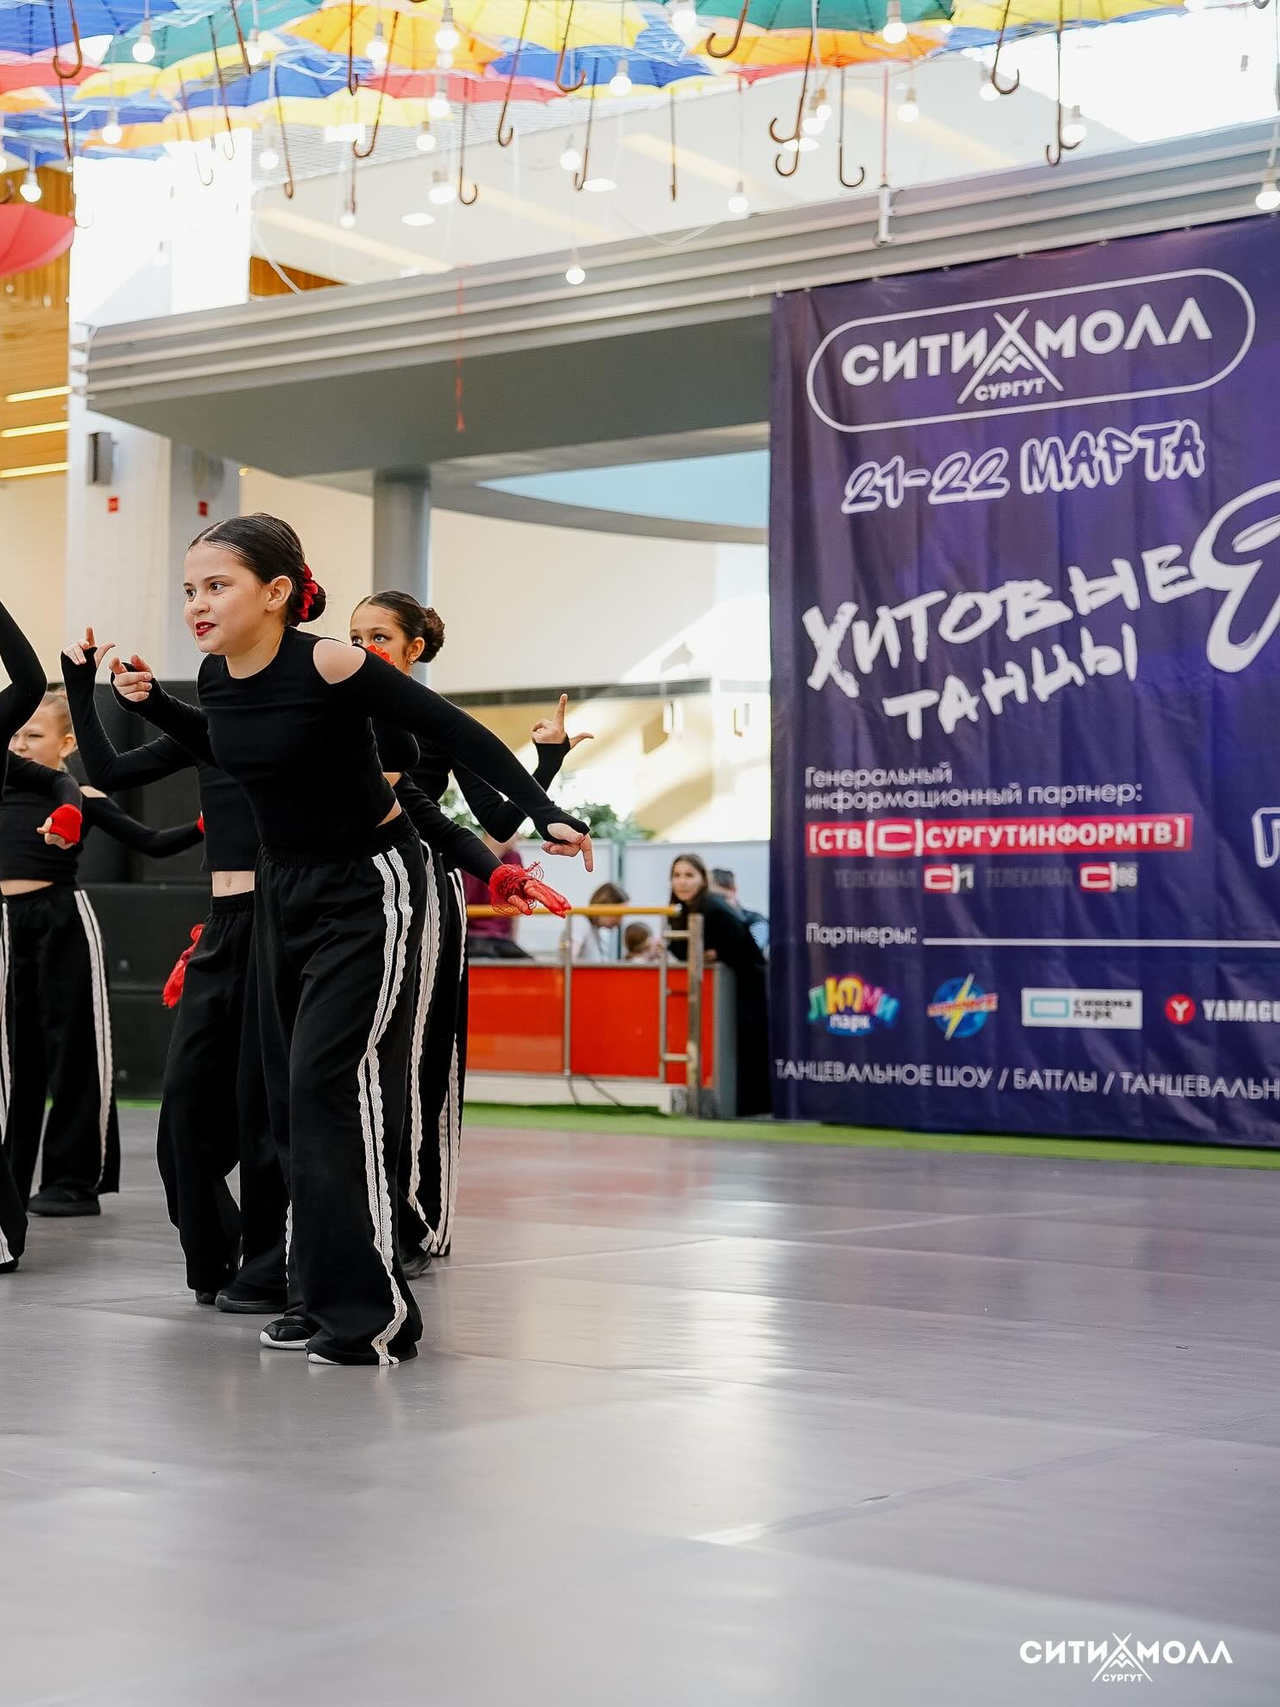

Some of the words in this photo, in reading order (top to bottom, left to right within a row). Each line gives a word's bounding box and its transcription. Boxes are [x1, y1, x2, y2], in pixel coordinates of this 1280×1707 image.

[841, 326, 988, 387] СИТИ
[1034, 296, 1213, 360] МОЛЛ
[973, 376, 1046, 402] СУРГУТ
[841, 446, 1010, 515] 21-22
[1019, 418, 1207, 495] МАРТА
[801, 544, 1204, 699] ХИТОВЫЕ
[882, 622, 1139, 741] ТАНЦЫ
[805, 761, 953, 788] Генеральный
[805, 781, 1023, 814] информационный
[1027, 782, 1143, 808] партнер:
[805, 922, 918, 948] Партнеры:
[775, 1058, 933, 1087] ТАНЦЕВАЛЬНОЕ
[936, 1064, 994, 1089] ШОУ
[1013, 1067, 1098, 1093] БАТТЛЫ
